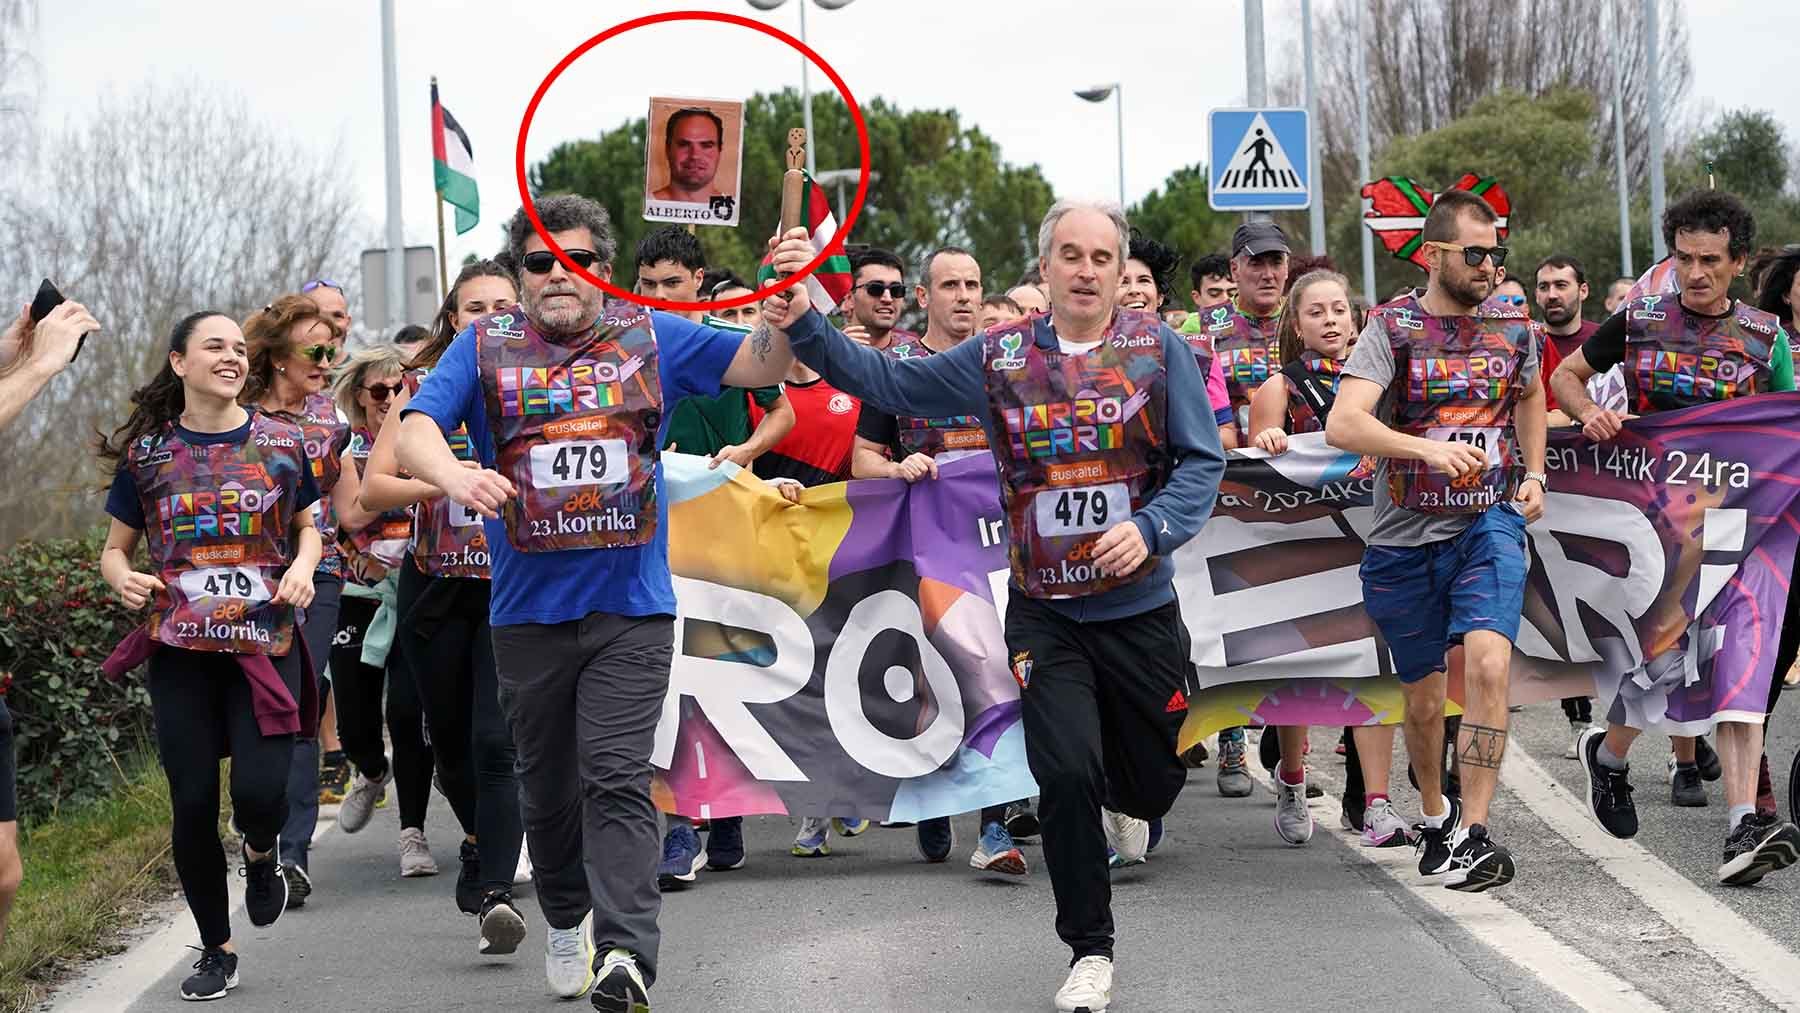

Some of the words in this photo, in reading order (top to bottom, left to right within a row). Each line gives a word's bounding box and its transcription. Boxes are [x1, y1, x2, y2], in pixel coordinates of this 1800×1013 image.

[646, 207, 711, 220] ALBERTO
[620, 314, 646, 328] eitb
[1750, 322, 1772, 335] eitb
[1127, 335, 1155, 347] eitb
[495, 362, 619, 391] HARRO
[1408, 356, 1507, 380] HARRO
[1636, 350, 1738, 381] HARRO
[547, 419, 603, 434] euskaltel
[1002, 396, 1122, 433] HARRO
[269, 436, 294, 447] eitb
[947, 433, 986, 444] euskalte
[552, 444, 608, 481] 479
[1051, 465, 1103, 481] euskaltel
[1587, 443, 1657, 483] 14tik
[1665, 450, 1749, 488] 24ra
[157, 488, 263, 521] HARRO
[564, 486, 604, 512] aek
[1055, 490, 1109, 527] 479
[530, 507, 637, 537] 23.korrika
[195, 550, 241, 561] euskaltel
[204, 571, 252, 597] 479
[213, 600, 249, 620] aek
[177, 617, 271, 643] 23.korrika
